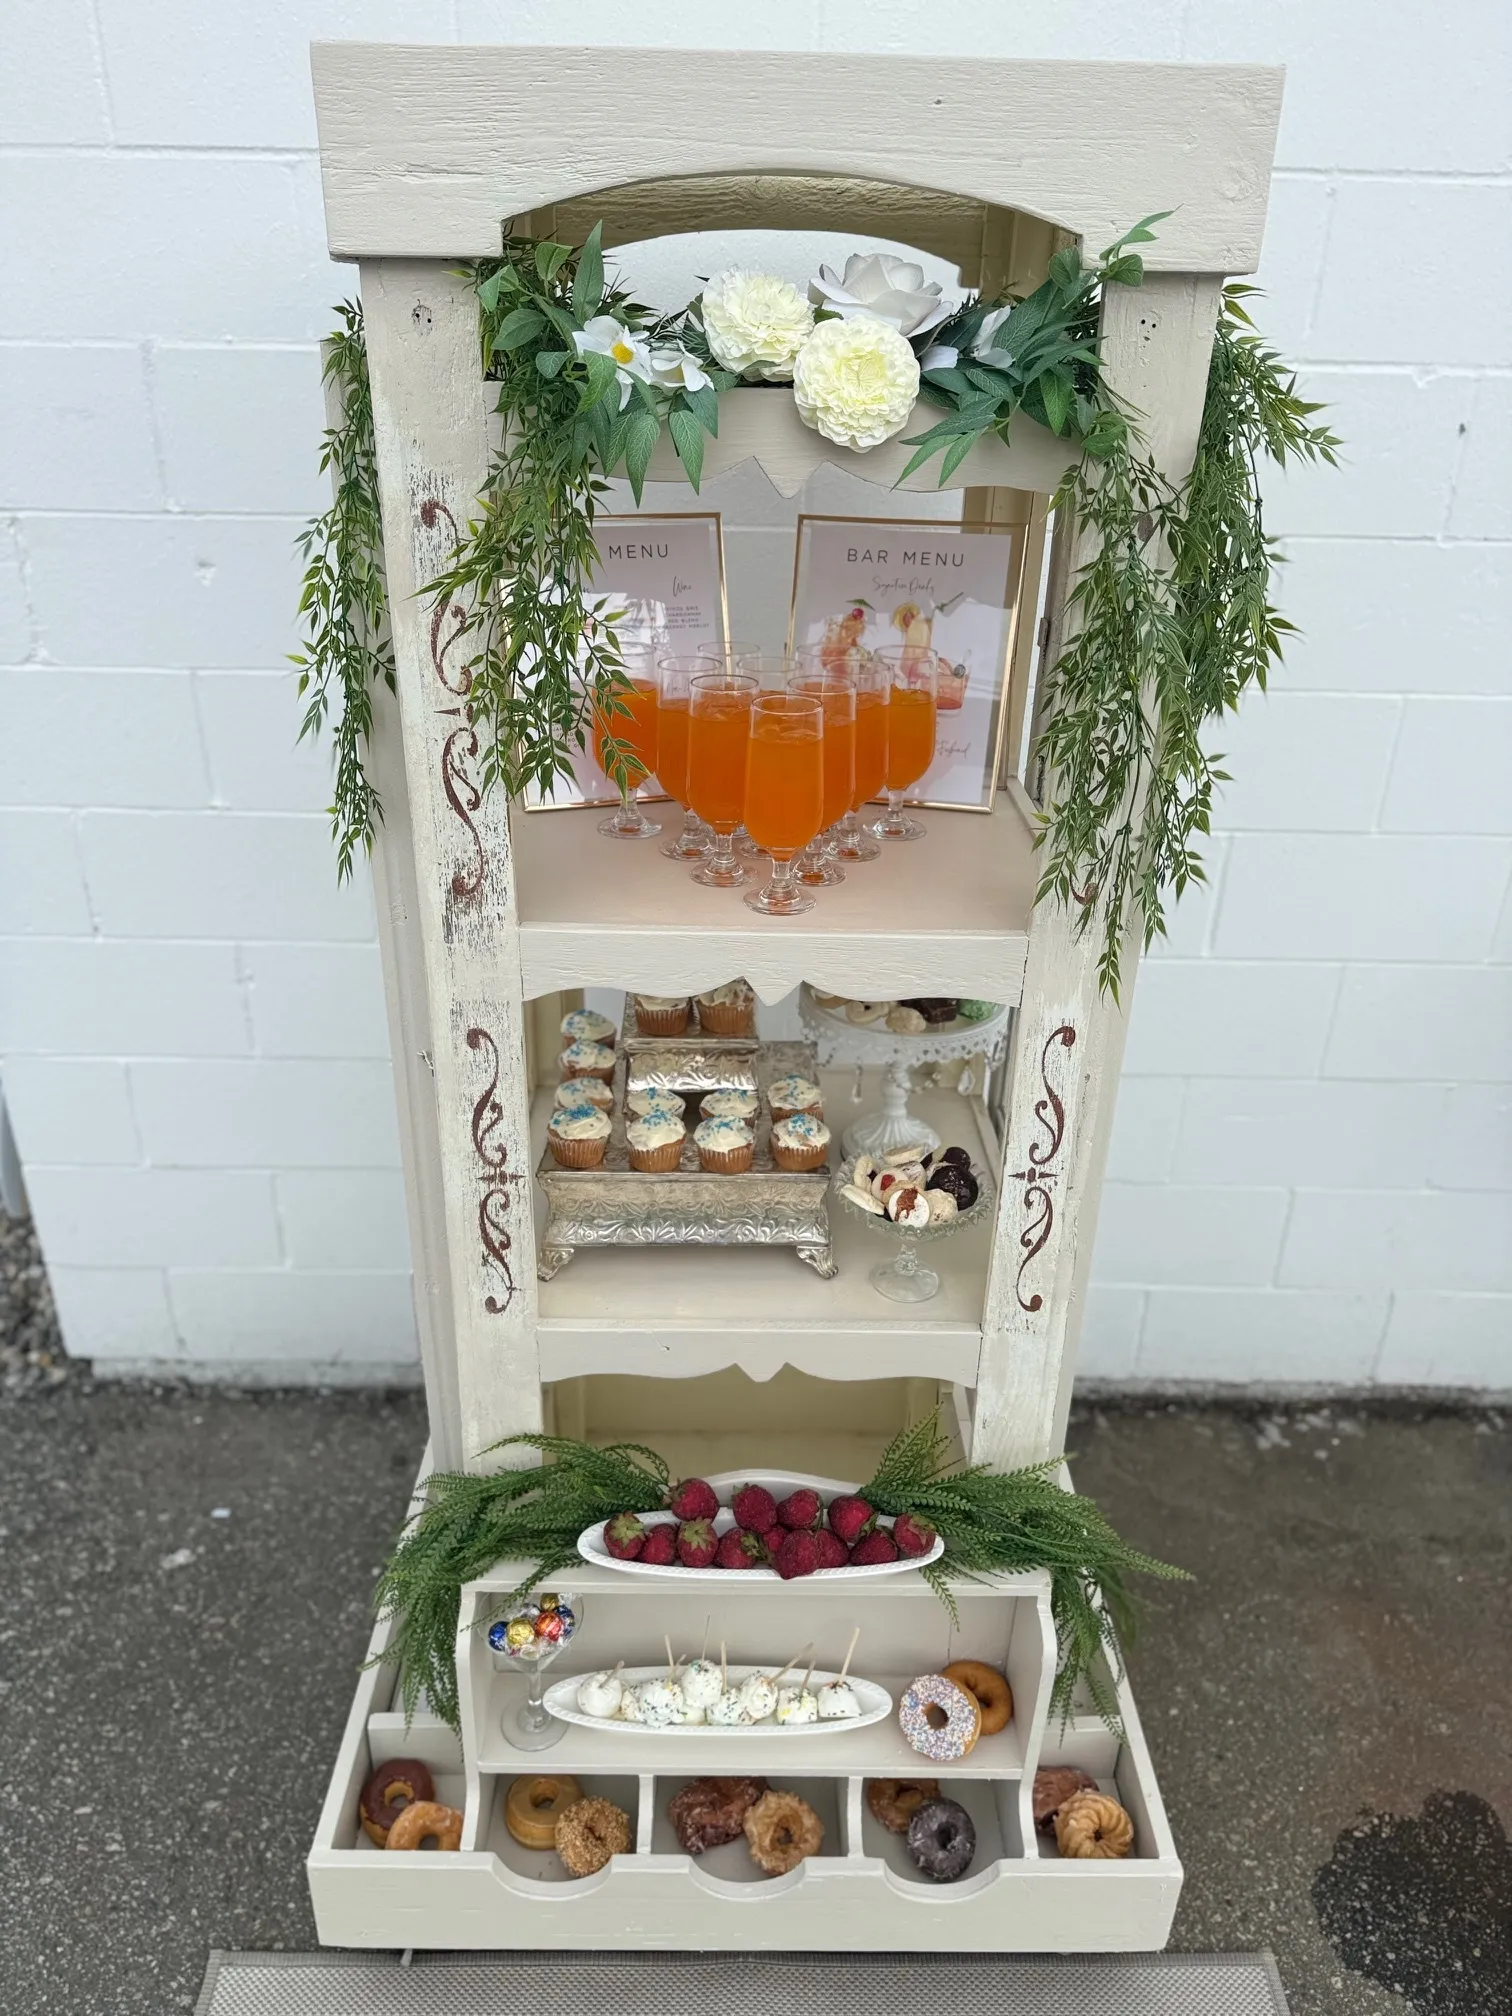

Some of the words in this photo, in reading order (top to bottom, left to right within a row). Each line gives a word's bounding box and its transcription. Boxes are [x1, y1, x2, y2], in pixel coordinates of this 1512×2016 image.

[608, 544, 669, 559] MENU
[847, 548, 888, 564] BAR
[903, 551, 964, 567] MENU
